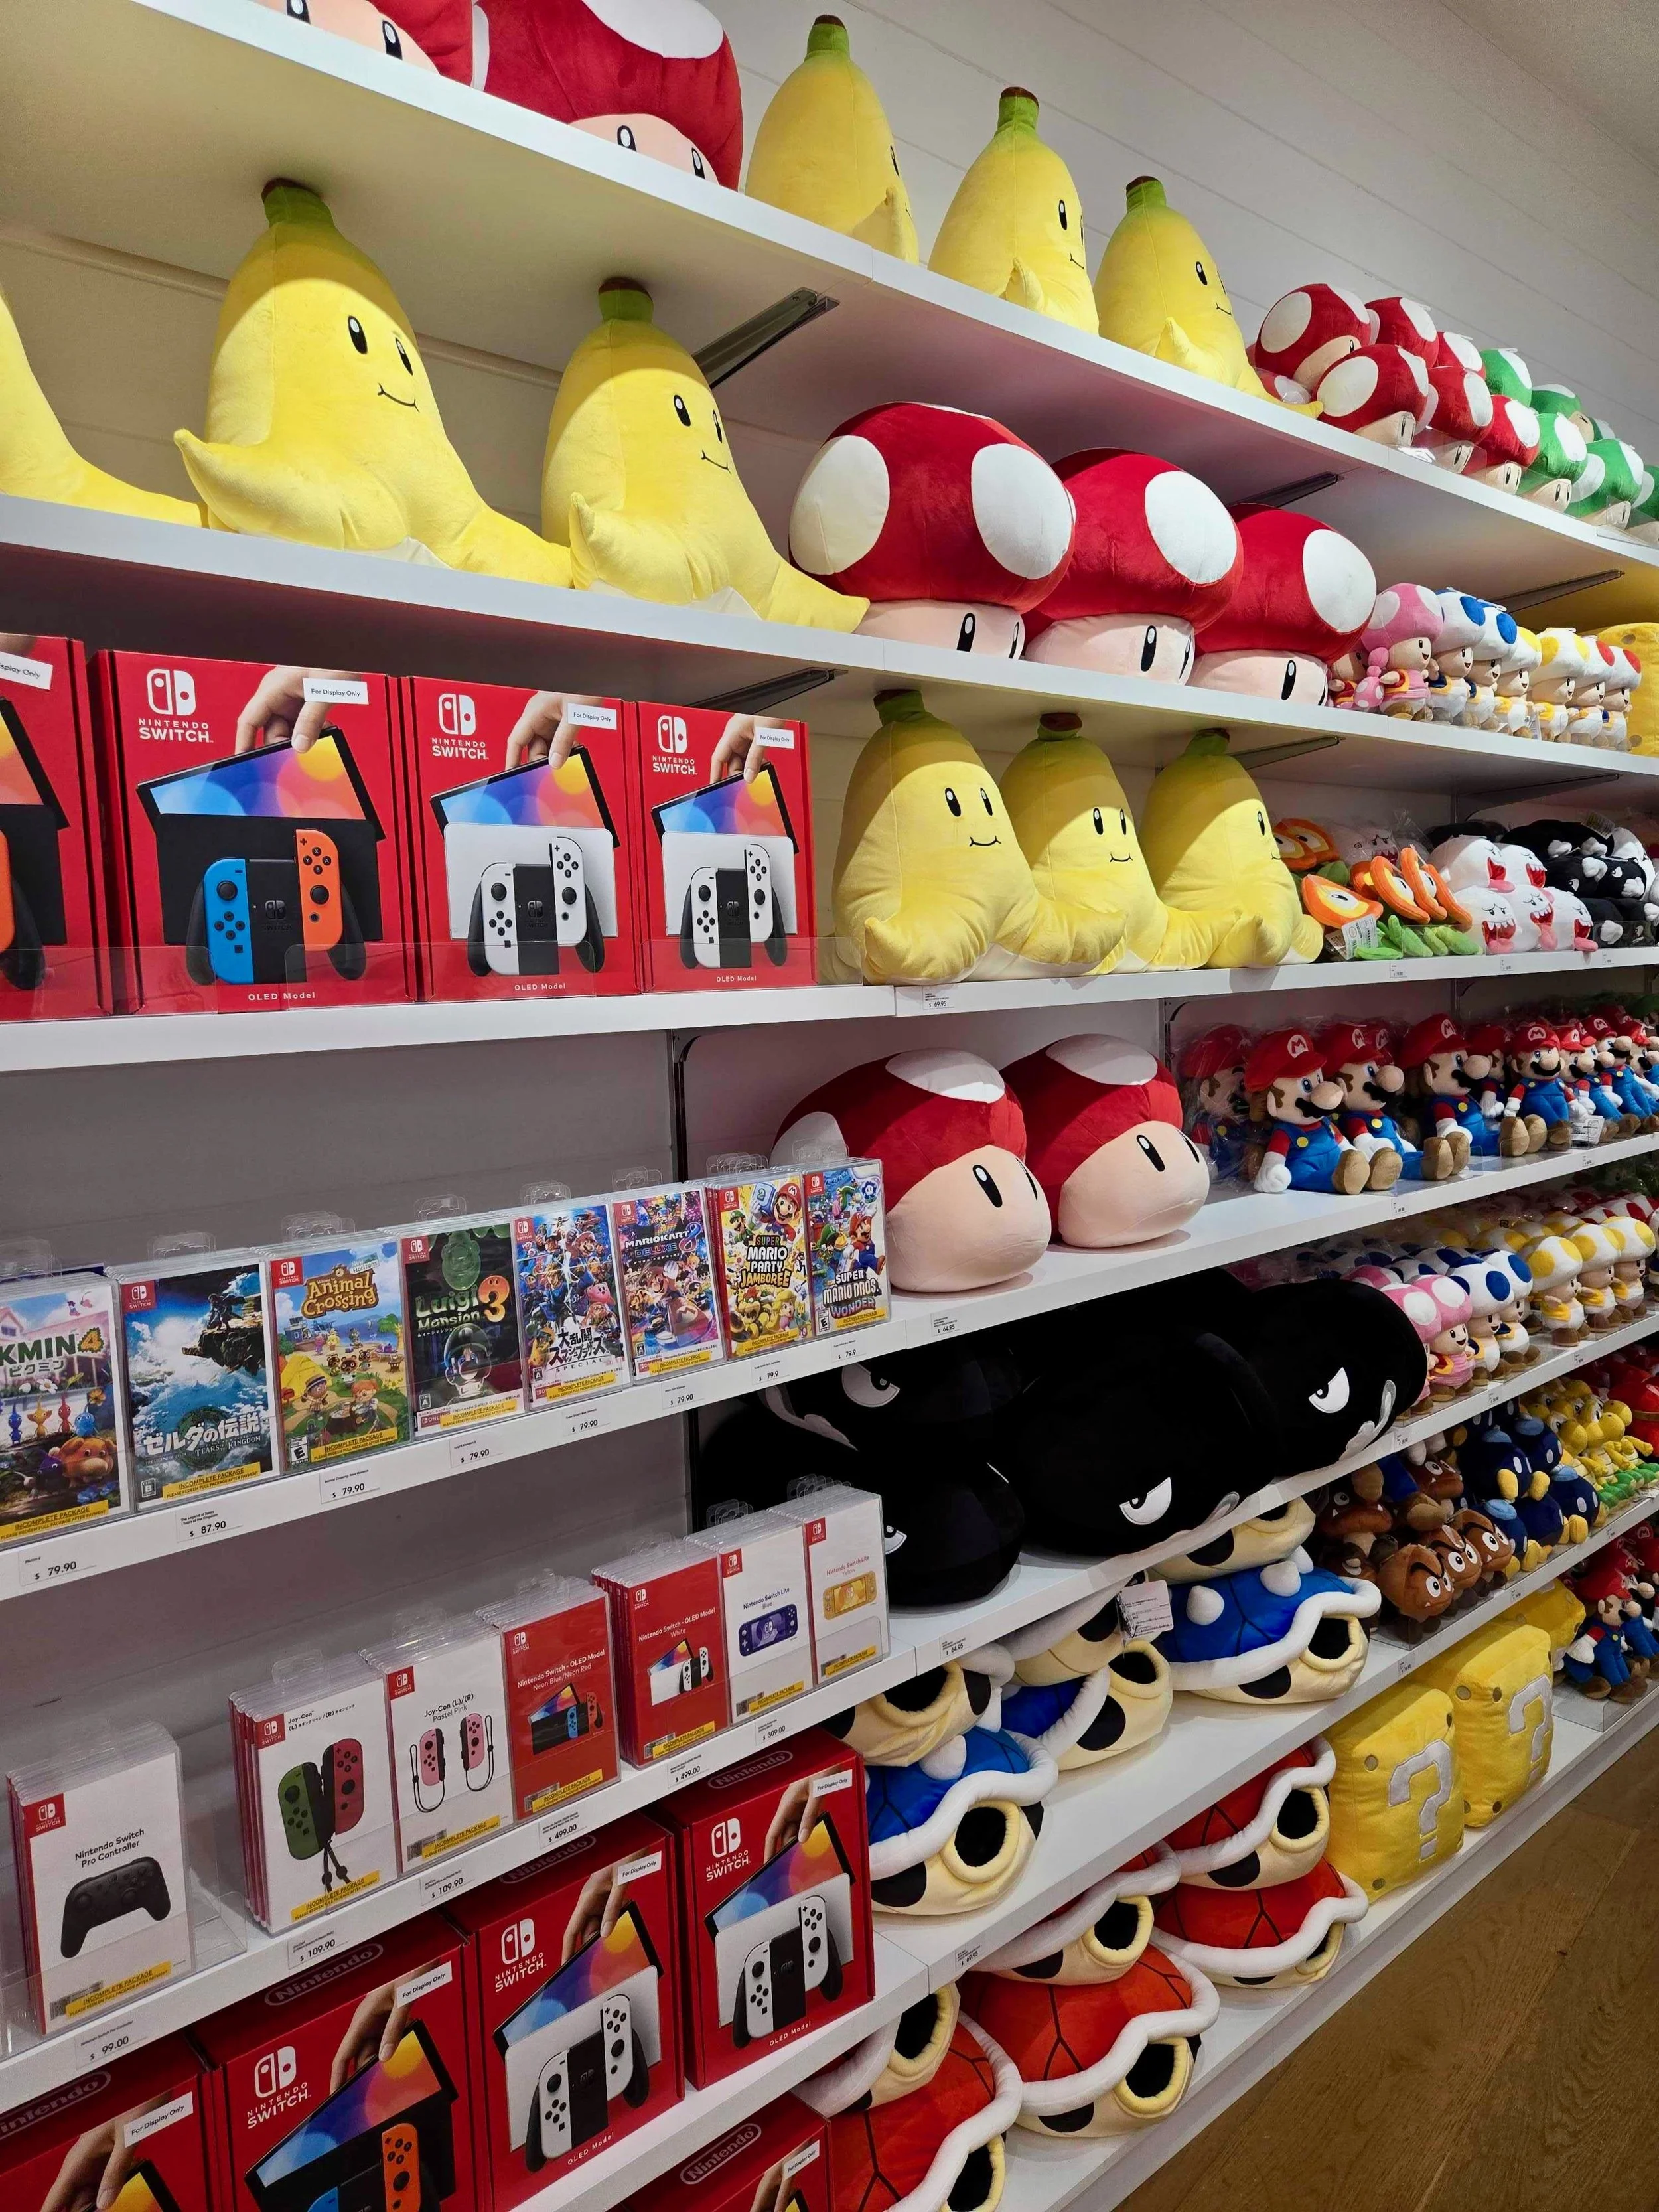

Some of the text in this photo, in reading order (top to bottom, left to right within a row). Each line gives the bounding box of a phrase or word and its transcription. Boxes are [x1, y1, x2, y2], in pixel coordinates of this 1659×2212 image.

[23, 669, 41, 680] Only
[139, 718, 208, 730] NINTENDO
[139, 728, 210, 743] SWITCH
[432, 737, 486, 747] NINTENDO
[432, 746, 486, 760] SWITCH
[652, 755, 695, 765] NINTENDO
[652, 763, 695, 775] SWITCH
[679, 1222, 702, 1253] 8
[757, 1236, 780, 1246] SUPER
[635, 1243, 677, 1258] DELUXE
[747, 1246, 788, 1260] MARIO
[352, 1260, 378, 1274] Horizons
[751, 1261, 783, 1272] PARTY
[309, 1272, 370, 1299] Animal
[740, 1270, 791, 1288] JAMBOREE
[836, 1270, 864, 1284] SUPER
[415, 1275, 510, 1323] Luigi 3
[824, 1278, 879, 1305] MARIO BROS.
[303, 1288, 376, 1316] Crossing
[831, 1297, 875, 1317] WONDER
[418, 1310, 480, 1331] Mansion
[78, 1327, 104, 1353] 4
[557, 1327, 593, 1349] 大乱闘
[9, 1360, 64, 1378] ピクミン
[556, 1358, 603, 1373] SPECIAL
[558, 1376, 604, 1392] INCOMPLETE PACKAGE
[678, 1394, 693, 1404] 79.90
[453, 1403, 504, 1420] INCOMPLETE PACKAGE
[143, 1412, 261, 1455] ゼルダの伝説
[580, 1420, 598, 1430] 79.90
[194, 1436, 261, 1457] TEARS KINGDOM
[325, 1432, 383, 1452] INCOMPLETE PACKAGE
[294, 1447, 305, 1459] E
[470, 1449, 490, 1460] 79.90
[179, 1468, 244, 1489] INCOMPLETE PACKAGE
[241, 1471, 259, 1480] PAYMENT
[342, 1483, 365, 1495] 79.90
[15, 1506, 90, 1530] INCOMPLETE PACKAGE
[86, 1510, 106, 1518] PAYMENT
[201, 1520, 226, 1534] 87.90
[48, 1561, 76, 1576] 79.90
[827, 1564, 846, 1576] Nintendo
[847, 1558, 861, 1569] Switch
[743, 1597, 764, 1610] Nintendo
[764, 1589, 780, 1601] Switch
[638, 1607, 715, 1642] Nintendo Switch OLED Model
[670, 1628, 686, 1638] White
[951, 1643, 964, 1653] 64.95
[517, 1649, 605, 1688] Nintendo Switch OLED Model
[533, 1663, 592, 1691] Neon Blue/Neon Red
[424, 1693, 474, 1718] Joy-Con (L)/(R)
[433, 1704, 467, 1722] Pastel Pink
[288, 1712, 313, 1724] Joy-Con
[768, 1726, 786, 1738] 309.00
[680, 1765, 700, 1779] 499.00
[716, 1754, 786, 1786] Nintendo
[544, 1775, 591, 1803] INCOMPLETE PACKAGE
[1388, 1739, 1454, 1862] ?
[35, 1820, 60, 1832] SWITCH
[435, 1832, 465, 1850] INCOMPLETE
[465, 1821, 487, 1835] PACKAGE
[555, 1824, 577, 1839] 499.00
[75, 1828, 145, 1861] Nintendo Switch
[82, 1840, 140, 1868] Pro Controller
[509, 1840, 588, 1880] Nintendo
[630, 1864, 646, 1874] Display
[706, 1850, 749, 1872] NINTENDO
[706, 1856, 750, 1881] SWITCH
[306, 1890, 340, 1910] INCOMPLETE
[340, 1878, 364, 1892] PACKAGE
[439, 1878, 463, 1895] 109.90
[308, 1939, 335, 1957] 109.90
[966, 1951, 978, 1962] 69.95
[495, 1952, 543, 1980] NINTENDO
[495, 1958, 544, 1992] SWITCH
[275, 1951, 374, 2001] Nintendo
[83, 1969, 153, 2005] INCOMPLETE PACKAGE
[402, 1973, 445, 1999] For Display Only
[769, 2021, 812, 2046] OLED Model
[102, 2035, 129, 2054] 99.00
[248, 2082, 307, 2117] NINTENDO
[248, 2089, 309, 2130] SWITCH
[131, 2105, 184, 2136] For Display Only
[567, 2132, 614, 2165] OLED Model
[687, 2128, 755, 2180] Nintendo
